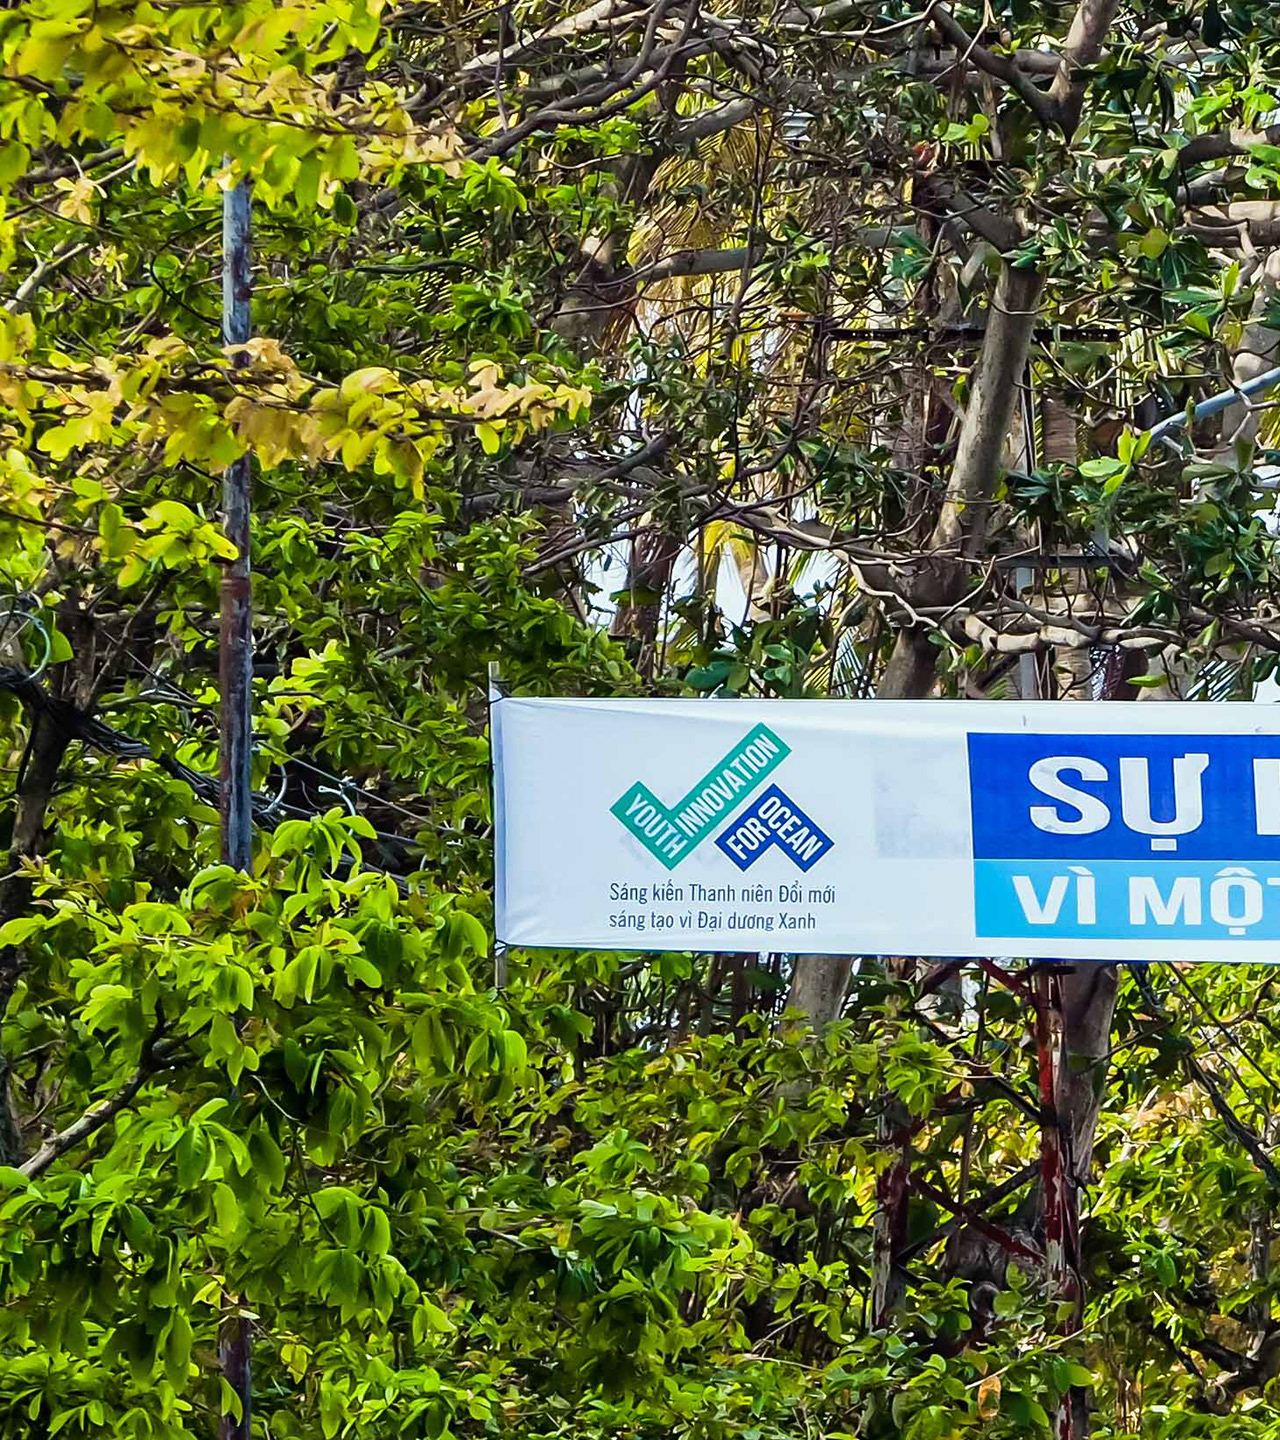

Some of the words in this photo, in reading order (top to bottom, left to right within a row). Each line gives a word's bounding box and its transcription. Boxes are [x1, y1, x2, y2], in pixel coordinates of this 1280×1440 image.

[674, 733, 780, 838] INNOVATION
[1027, 752, 1210, 852] SỰ
[624, 793, 688, 860] YOUTH
[725, 816, 771, 861] FOR
[757, 796, 824, 862] OCEAN
[609, 909, 645, 930] sáng
[651, 912, 674, 931] tạo
[680, 910, 692, 928] vì
[698, 911, 722, 932] Đại
[727, 912, 774, 931] dương
[778, 913, 816, 929] Xanh
[610, 882, 647, 904] Sáng
[653, 879, 683, 901] kiến
[689, 884, 736, 902] Thanh
[741, 884, 773, 903] niên
[779, 880, 802, 903] Đổi
[808, 885, 835, 903] mới
[1011, 867, 1096, 926] VÌ
